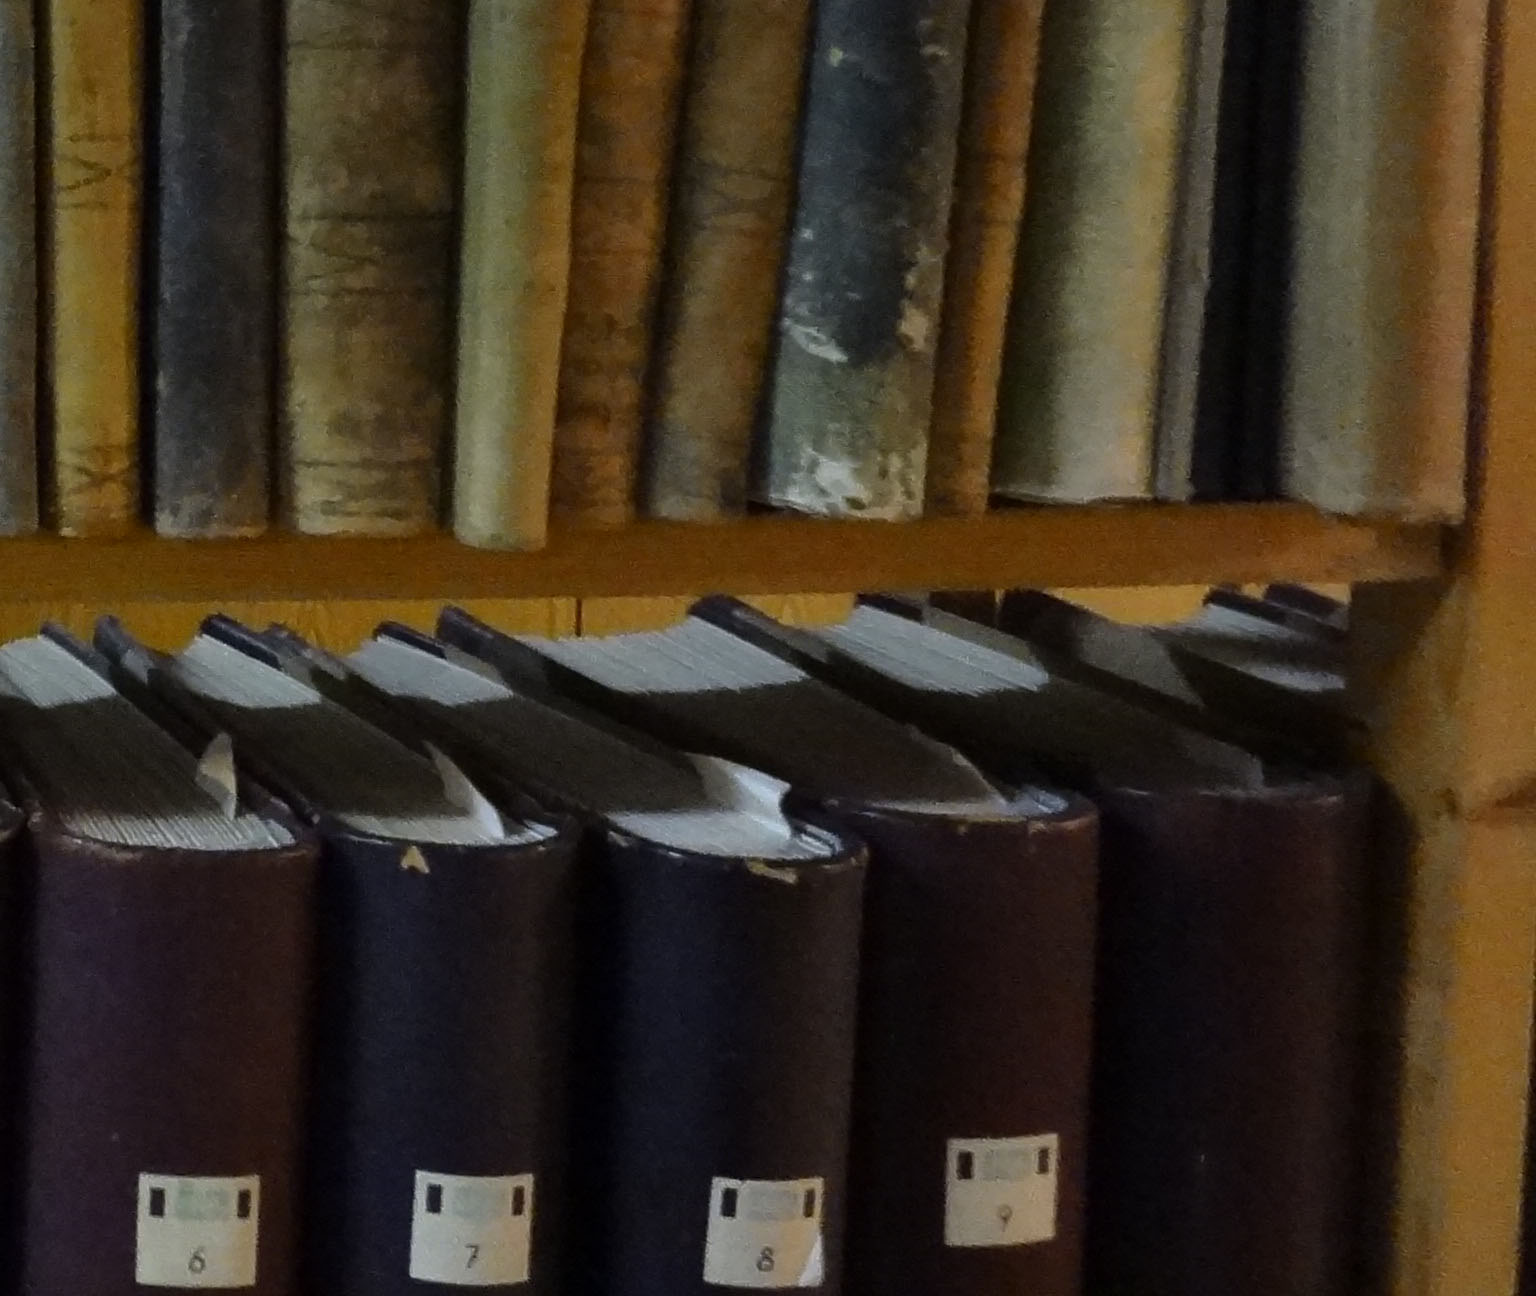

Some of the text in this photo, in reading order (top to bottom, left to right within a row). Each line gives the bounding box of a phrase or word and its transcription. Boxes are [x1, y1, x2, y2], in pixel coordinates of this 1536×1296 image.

[997, 1204, 1014, 1233] 9
[187, 1246, 208, 1275] 6
[463, 1244, 480, 1270] 7
[756, 1246, 775, 1273] 8
